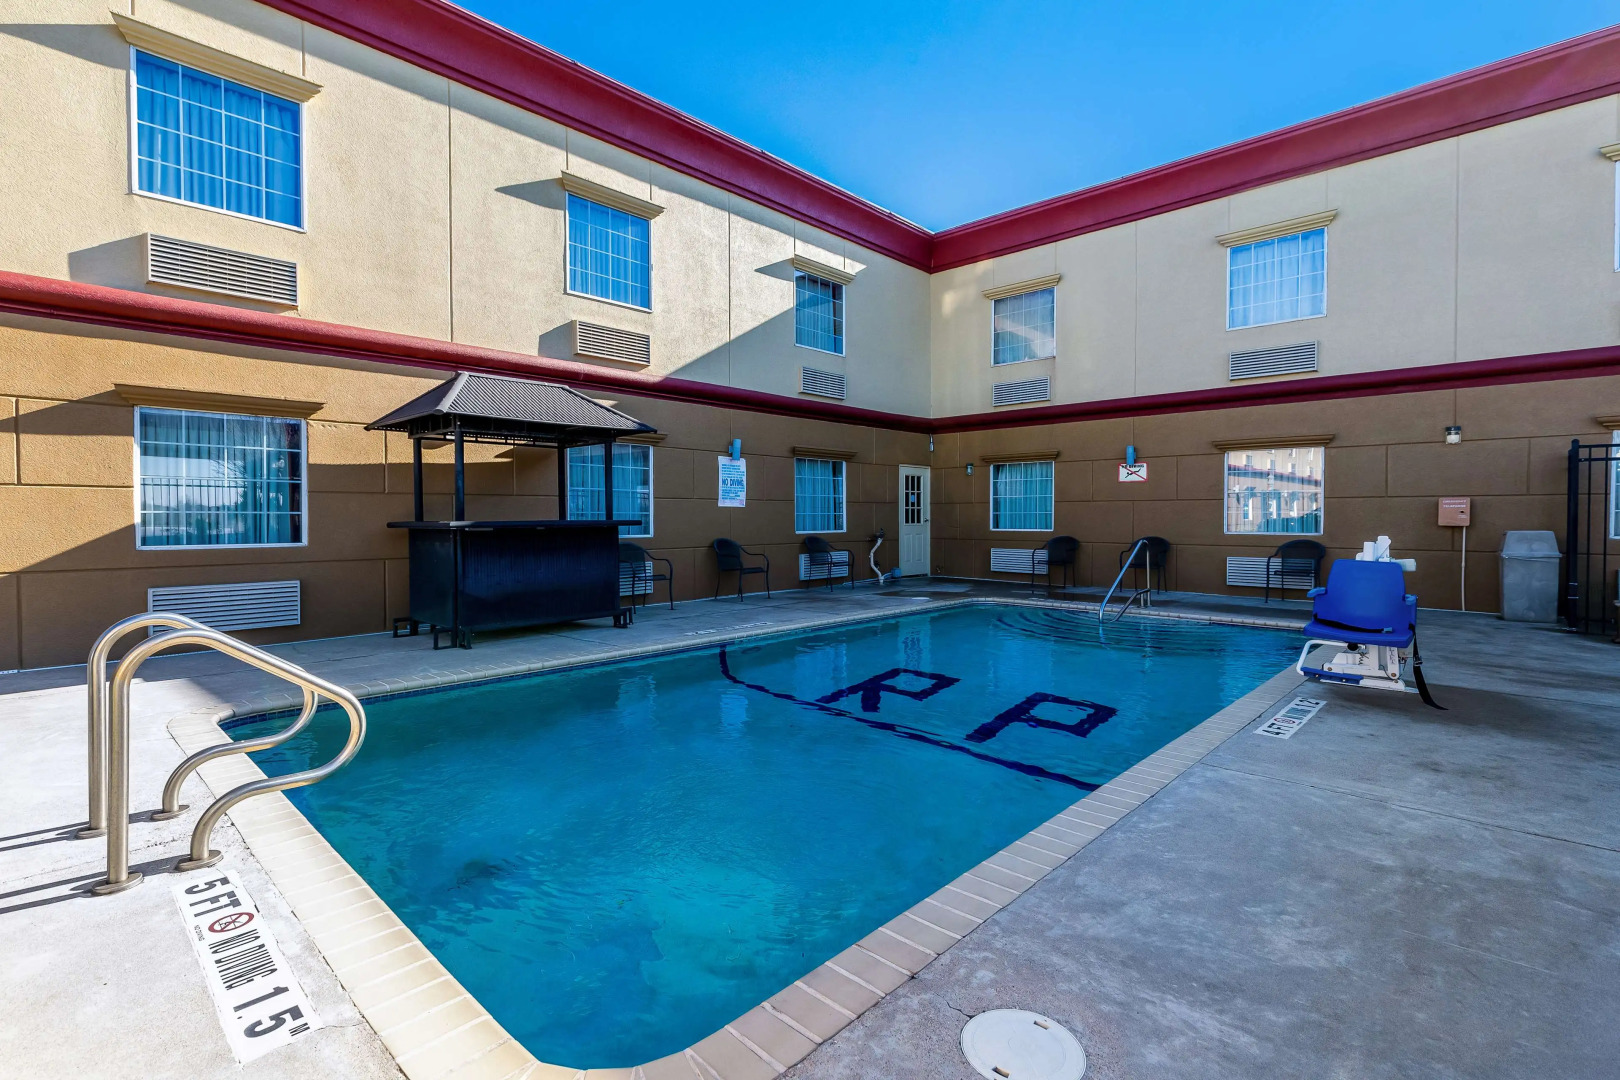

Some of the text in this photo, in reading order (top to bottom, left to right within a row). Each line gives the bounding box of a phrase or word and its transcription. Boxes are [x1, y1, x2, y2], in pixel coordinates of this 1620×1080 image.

[722, 478, 744, 486] NO DIVING
[184, 876, 242, 918] 5 FT
[208, 928, 278, 991] NO DIVING
